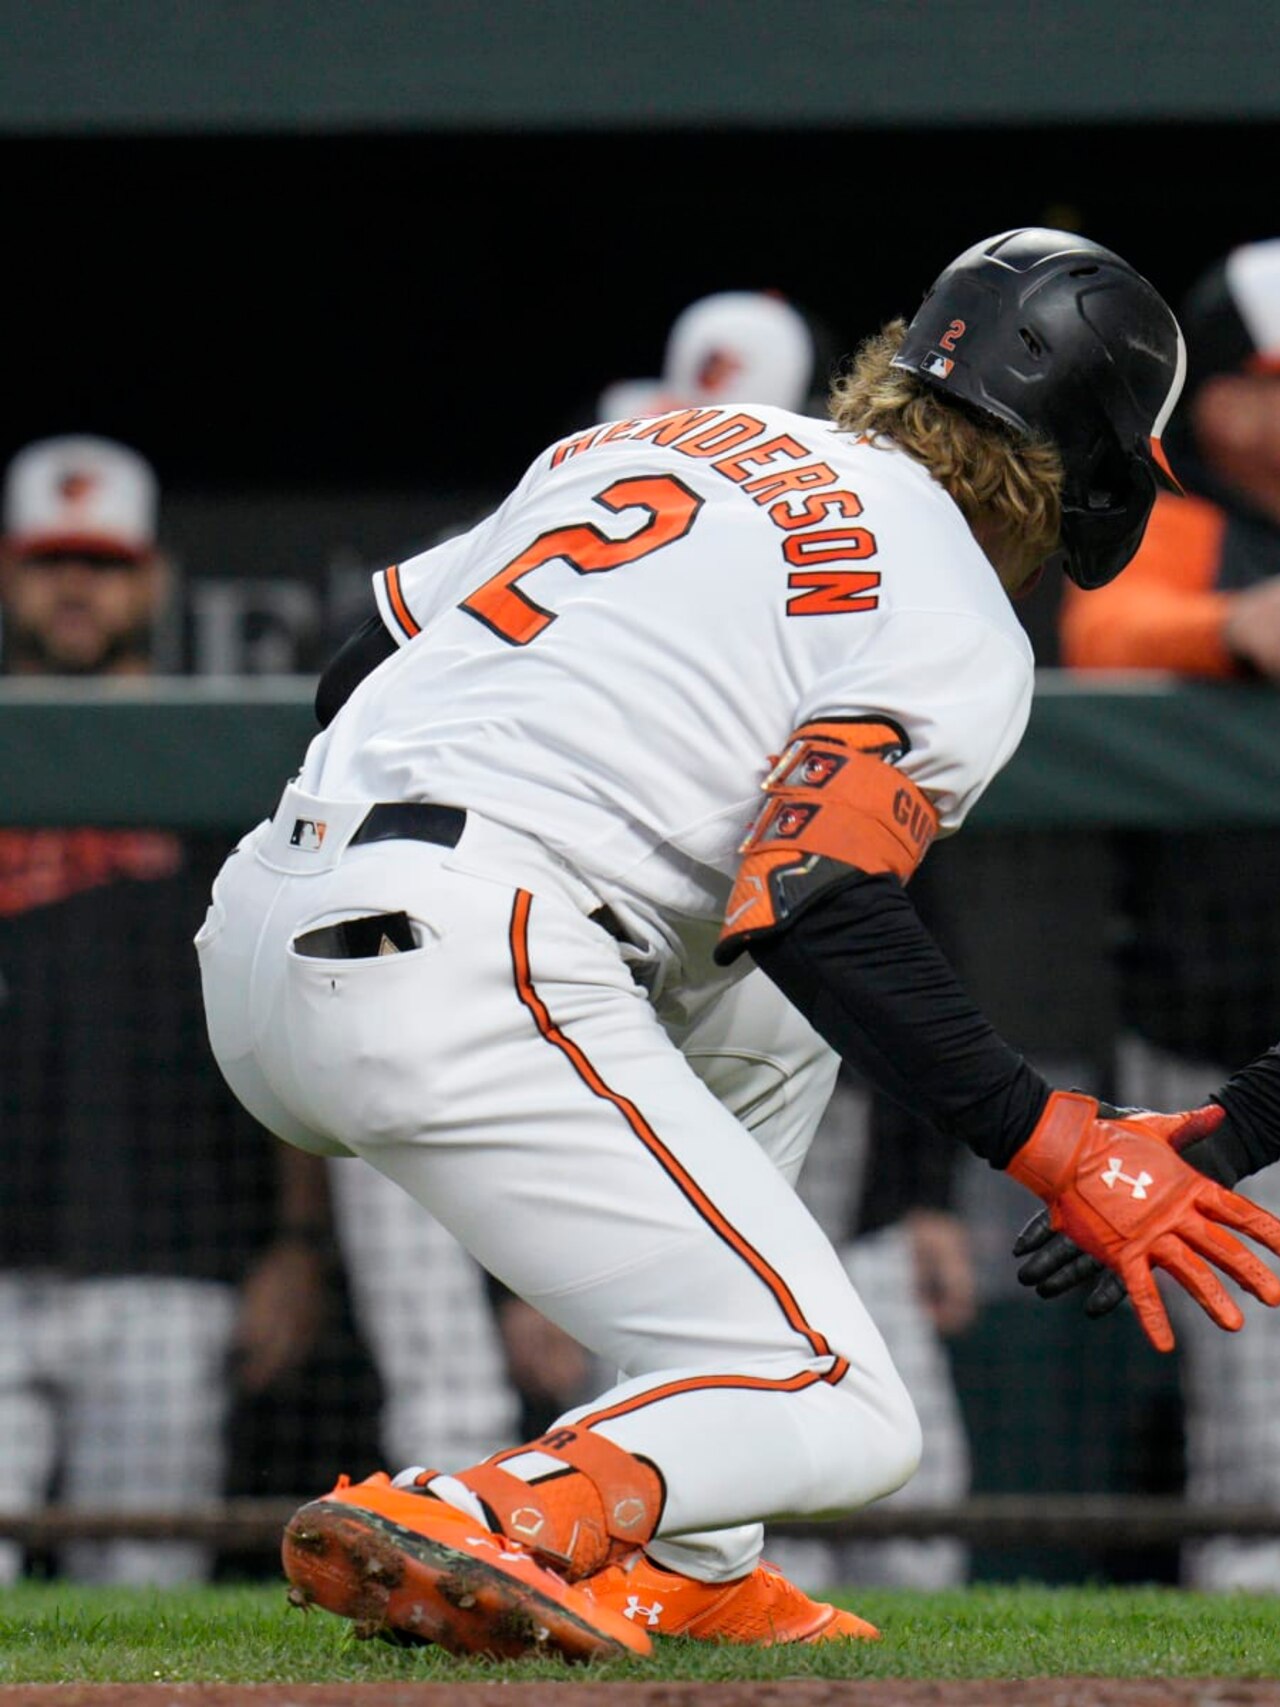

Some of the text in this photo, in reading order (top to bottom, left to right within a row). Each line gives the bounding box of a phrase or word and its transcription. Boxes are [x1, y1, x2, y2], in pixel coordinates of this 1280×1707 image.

[939, 319, 966, 352] 2
[457, 473, 706, 647] 2
[549, 408, 882, 617] HENDERSON
